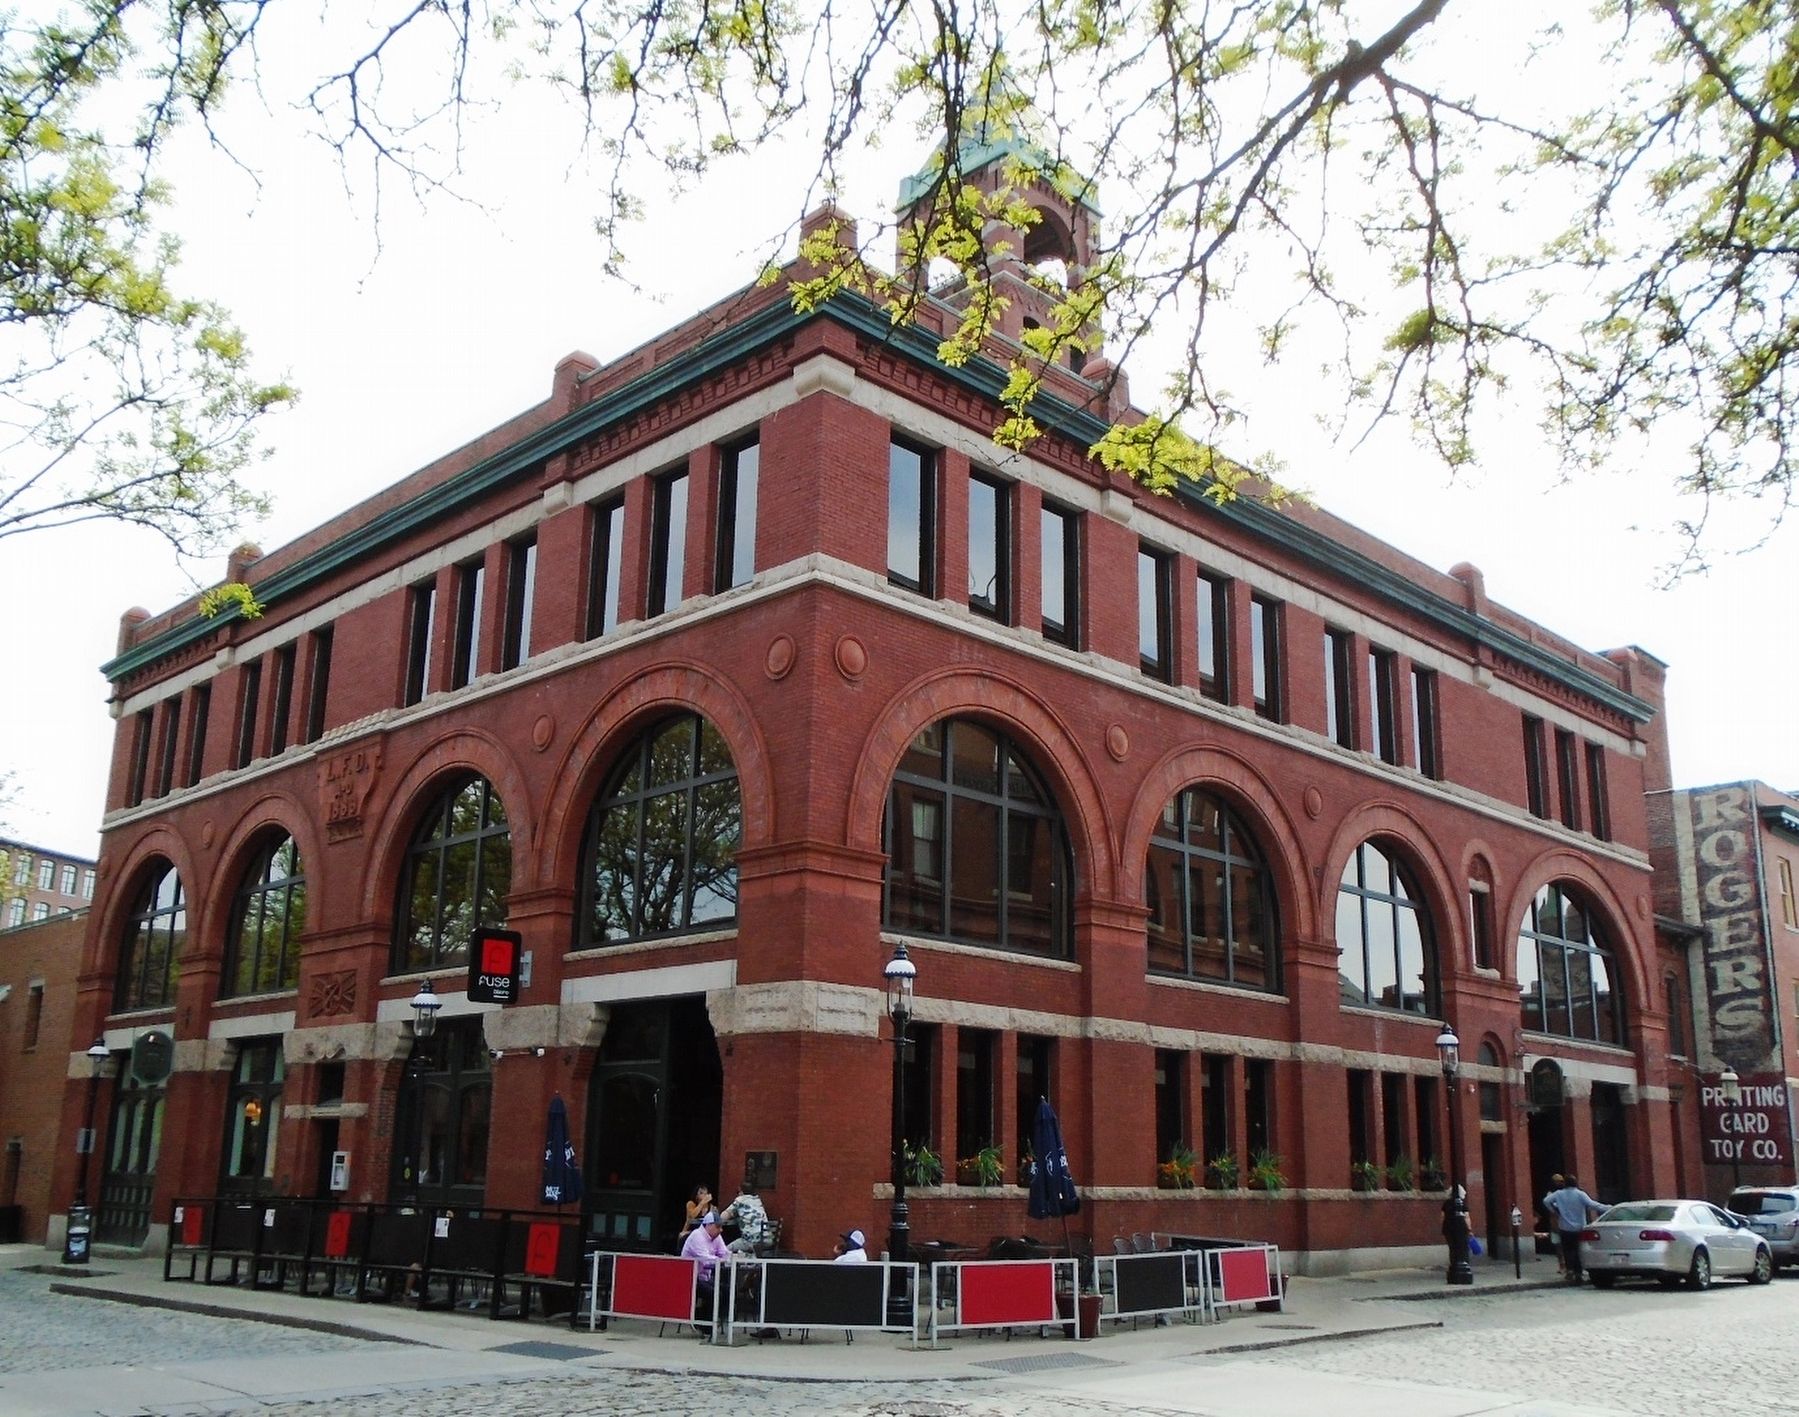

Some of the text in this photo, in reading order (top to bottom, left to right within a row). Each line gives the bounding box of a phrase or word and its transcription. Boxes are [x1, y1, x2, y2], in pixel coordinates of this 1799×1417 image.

[1695, 787, 1764, 1040] ROGERS
[1702, 1084, 1785, 1107] PRNTING
[1720, 1112, 1769, 1133] CARD
[1710, 1140, 1783, 1160] TOY CO.
